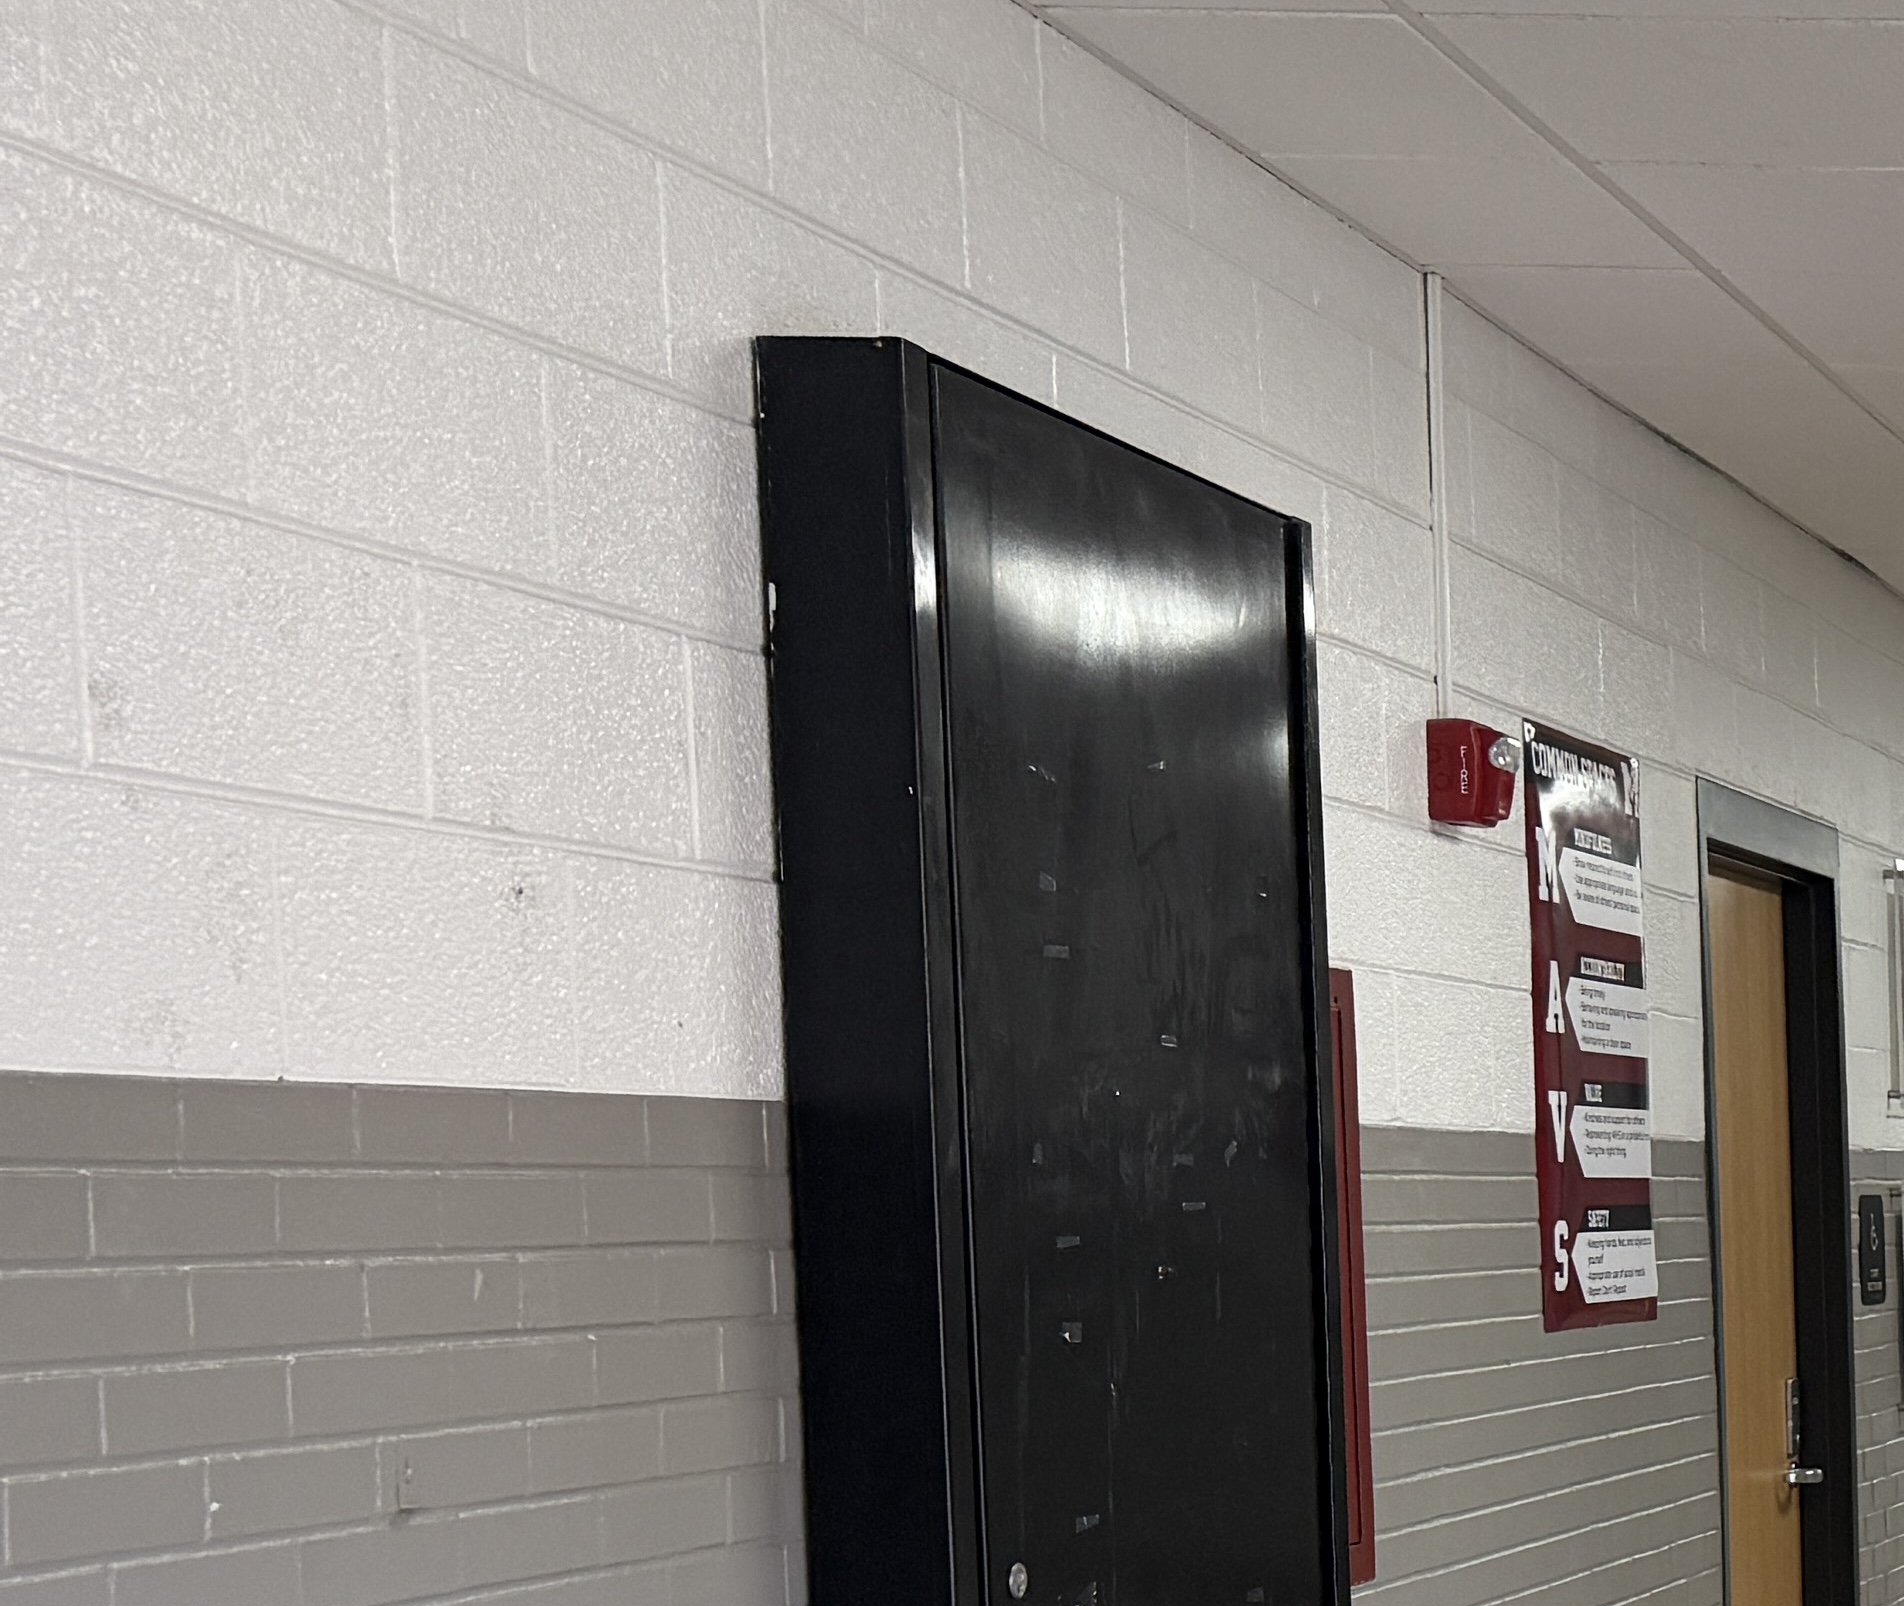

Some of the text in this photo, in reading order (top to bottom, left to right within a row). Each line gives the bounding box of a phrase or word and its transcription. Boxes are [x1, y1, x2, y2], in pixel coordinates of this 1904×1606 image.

[1460, 745, 1469, 794] FIRE
[1531, 741, 1579, 785] COMMON
[1546, 960, 1565, 1034] A
[1548, 1090, 1567, 1163] V
[1554, 1220, 1569, 1292] S
